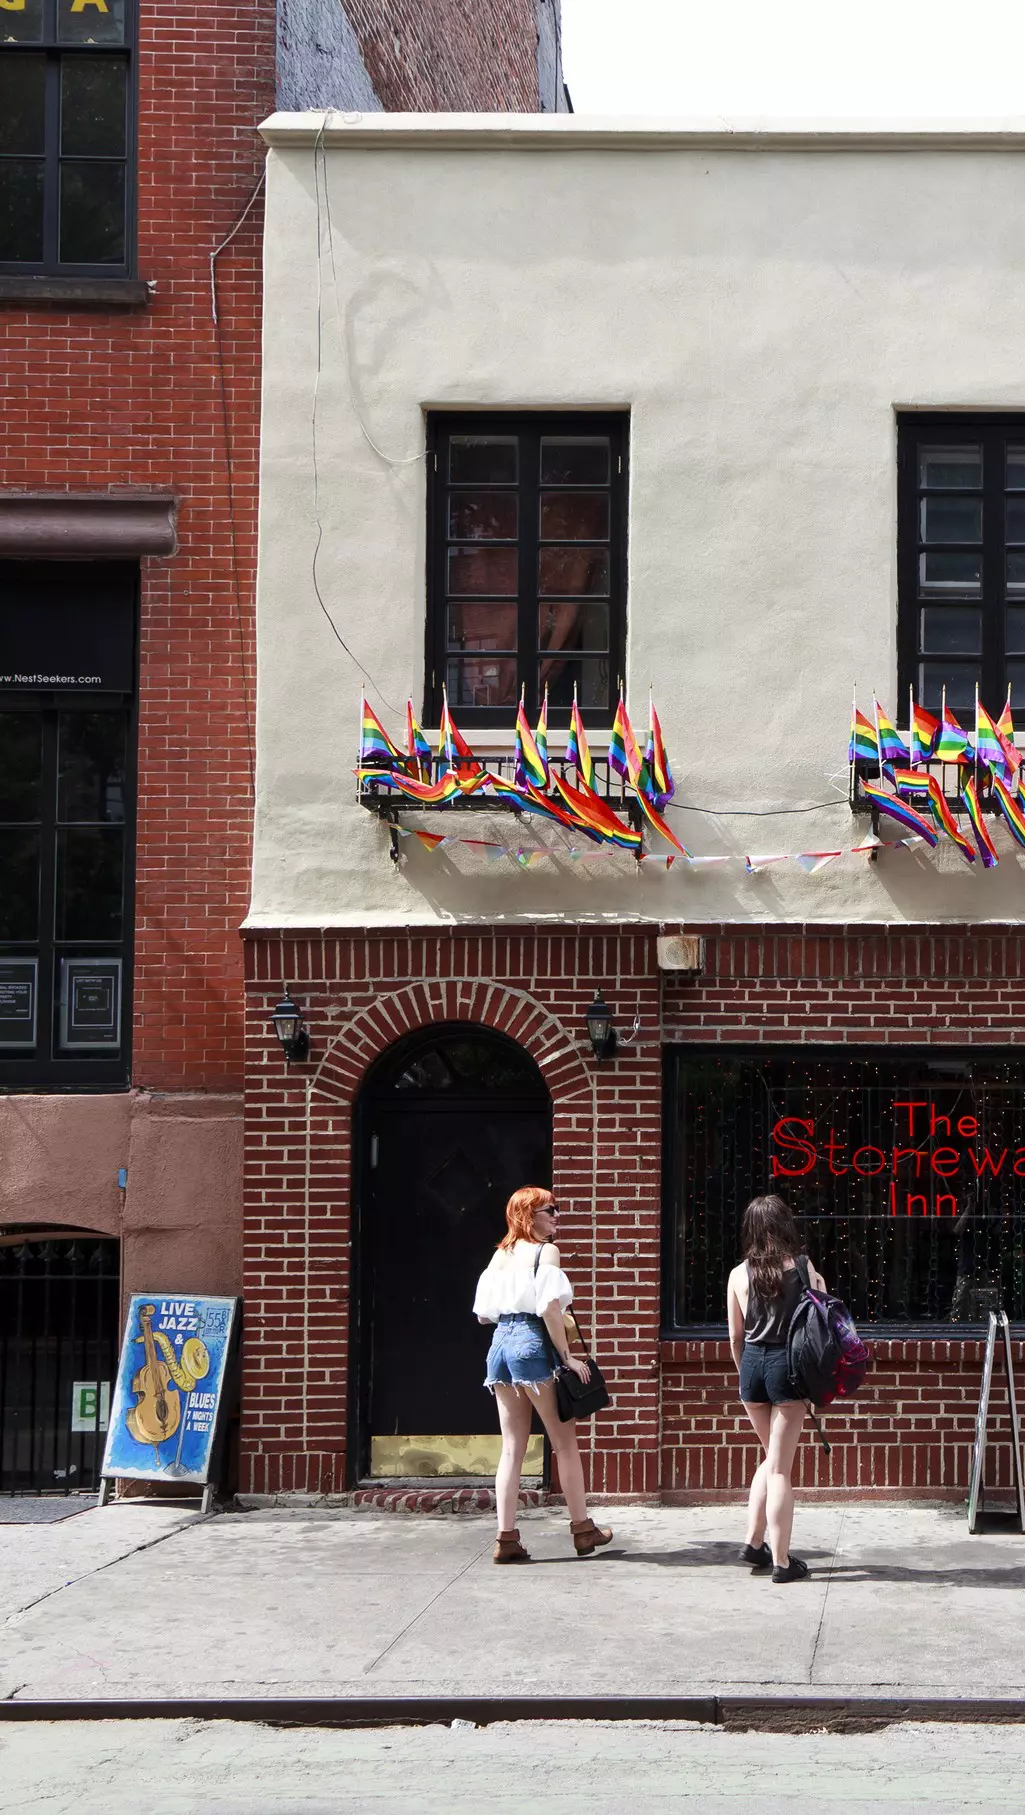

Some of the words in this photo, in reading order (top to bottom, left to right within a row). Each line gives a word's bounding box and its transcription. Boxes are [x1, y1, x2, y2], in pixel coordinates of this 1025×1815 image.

[893, 1102, 979, 1137] The
[889, 1181, 958, 1218] Inn
[160, 1301, 196, 1316] LIVE
[158, 1316, 199, 1331] JAZZ
[174, 1333, 184, 1345] &
[80, 1389, 97, 1418] B
[189, 1392, 216, 1409] BLUES
[186, 1411, 191, 1420] 7
[192, 1411, 214, 1422] NIGHTS
[186, 1423, 191, 1431] A
[193, 1422, 209, 1432] WEEK
